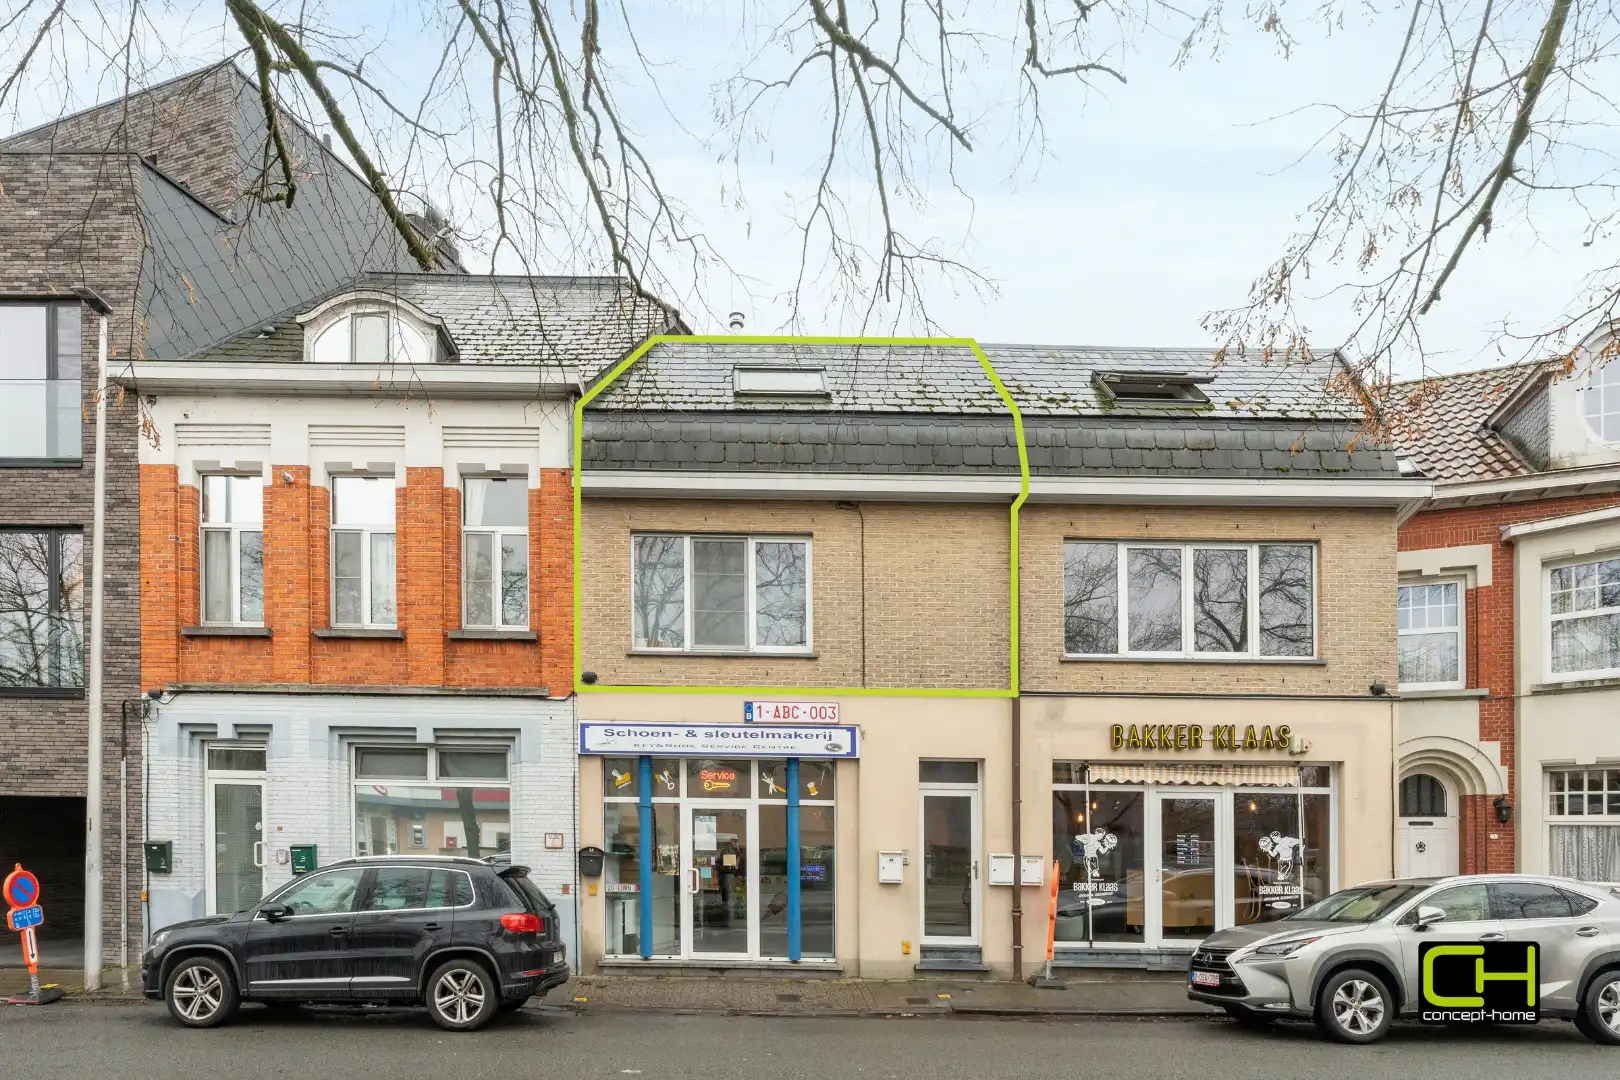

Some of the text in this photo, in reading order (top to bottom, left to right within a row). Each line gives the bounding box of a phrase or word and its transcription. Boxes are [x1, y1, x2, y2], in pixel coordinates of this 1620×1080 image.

[603, 728, 833, 741] Schoen- & sleutelmakerij
[1111, 724, 1291, 749] BAKKER KLAAS
[701, 770, 735, 780] Service
